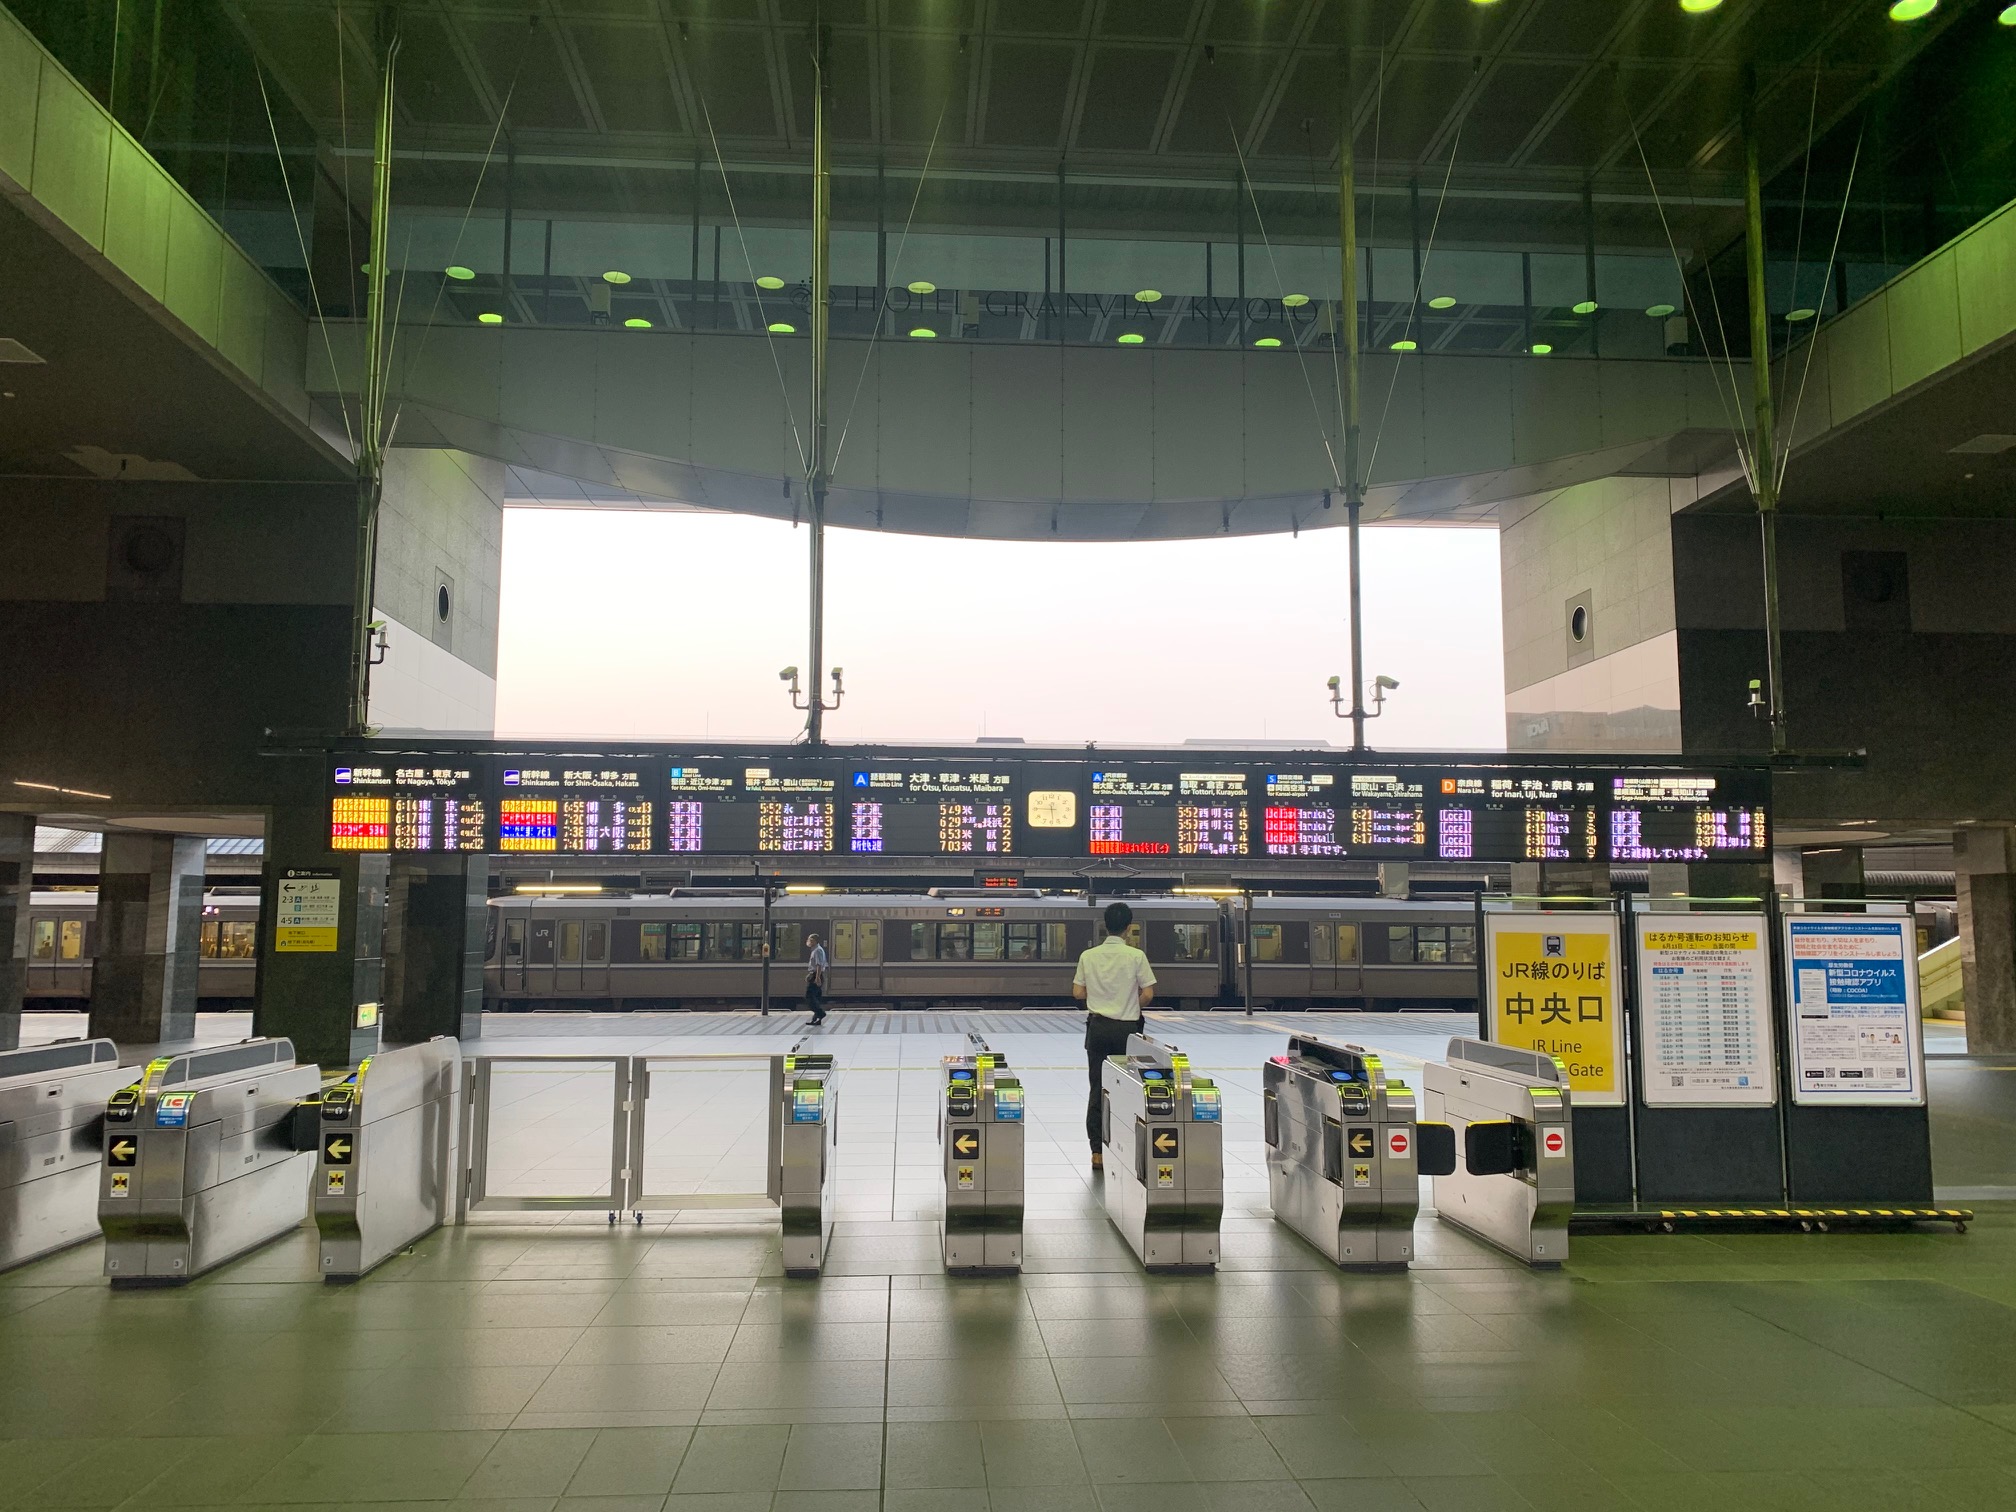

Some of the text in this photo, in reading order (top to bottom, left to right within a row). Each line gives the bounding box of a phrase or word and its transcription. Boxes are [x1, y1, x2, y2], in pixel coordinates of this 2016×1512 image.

[986, 290, 1154, 321] GRANVIA
[563, 771, 619, 780] 新大阪・博多
[407, 778, 435, 786] Nagoya,
[1352, 782, 1404, 791] 和歌山・白浜
[1491, 780, 1573, 790] 稲荷・宇治・奈良
[1576, 782, 1594, 791] 方面
[910, 784, 920, 792] for
[942, 784, 972, 792] Kusatsu,
[973, 784, 1004, 792] Maibara
[1191, 788, 1216, 796] Tottori,
[1216, 788, 1248, 797] Kurayoshi
[1394, 790, 1423, 798] Shirahama
[1504, 791, 1524, 800] Inari,
[1525, 791, 1538, 800] Uji,
[396, 800, 417, 811] 6:14
[825, 804, 833, 814] 3
[1002, 805, 1011, 816] 2
[396, 812, 417, 824] 6:17
[1239, 808, 1248, 818] 4
[1352, 810, 1372, 820] 6:21
[1754, 812, 1764, 823] 33
[825, 816, 833, 826] 3
[1002, 817, 1011, 828] 2
[1239, 820, 1248, 830] 5
[825, 828, 833, 838] 3
[1002, 829, 1011, 840] 2
[1754, 824, 1764, 835] 32
[1239, 832, 1248, 842] 4
[1754, 836, 1764, 848] 32
[760, 840, 833, 850] 6:45 3
[1002, 841, 1011, 852] 2
[1239, 844, 1248, 854] 5
[1649, 932, 1750, 942] はるか号運転のお知らせ
[1502, 960, 1606, 980] JR線のりば
[1828, 969, 1896, 977] 新型コロナウイルス
[1830, 978, 1882, 986] 接触確認アプリ
[1505, 992, 1604, 1025] 中央口
[1552, 1039, 1582, 1054] Line
[1569, 1062, 1604, 1077] Gate
